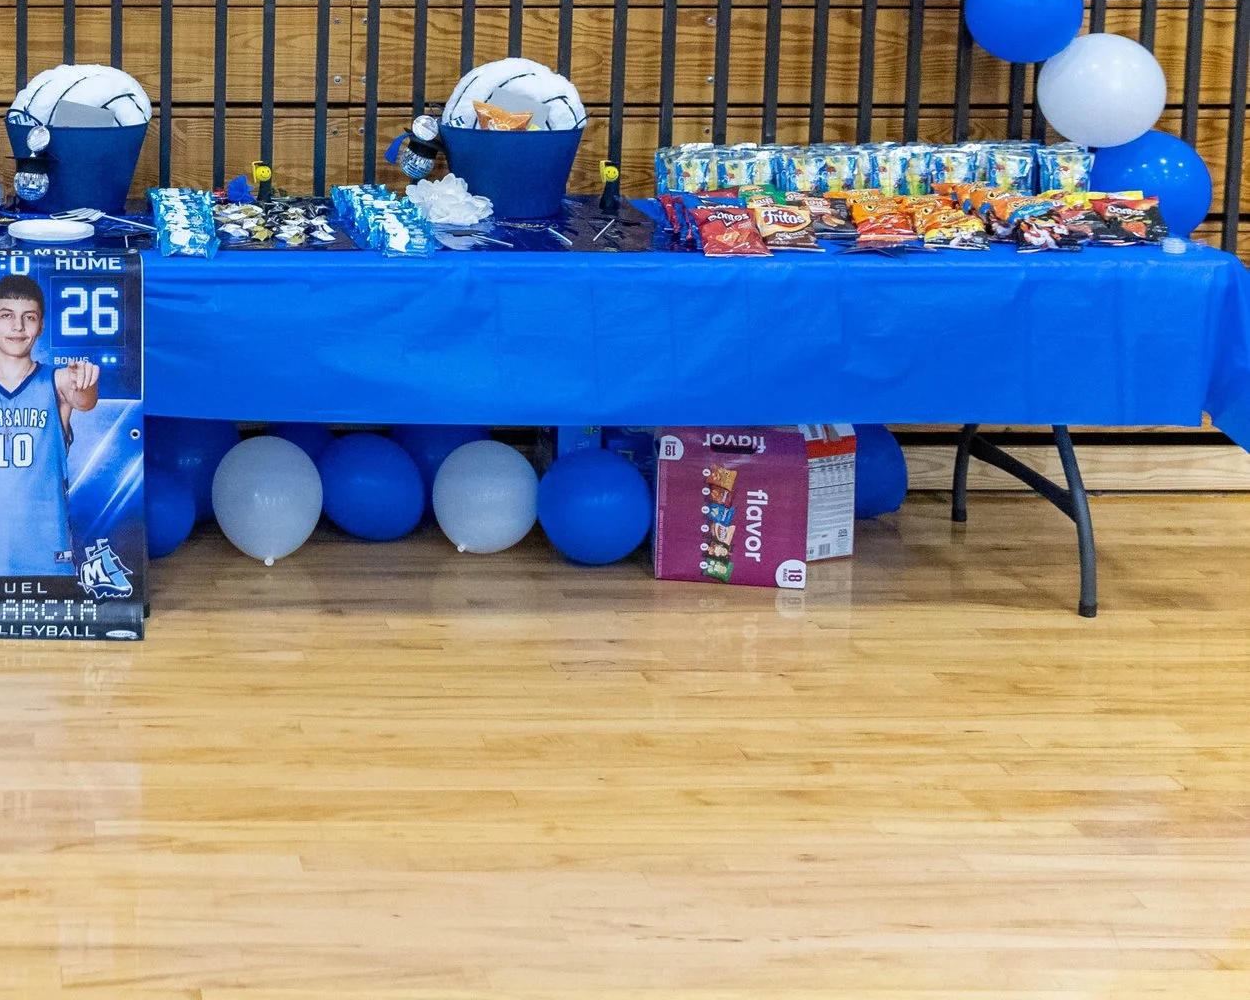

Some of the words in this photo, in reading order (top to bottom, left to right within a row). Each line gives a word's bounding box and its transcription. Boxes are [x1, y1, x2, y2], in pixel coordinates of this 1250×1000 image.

[761, 210, 806, 225] Fritos
[55, 257, 121, 270] HOME
[61, 287, 119, 336] 26
[665, 445, 676, 457] 18
[744, 489, 768, 563] flavor
[788, 568, 803, 582] 18
